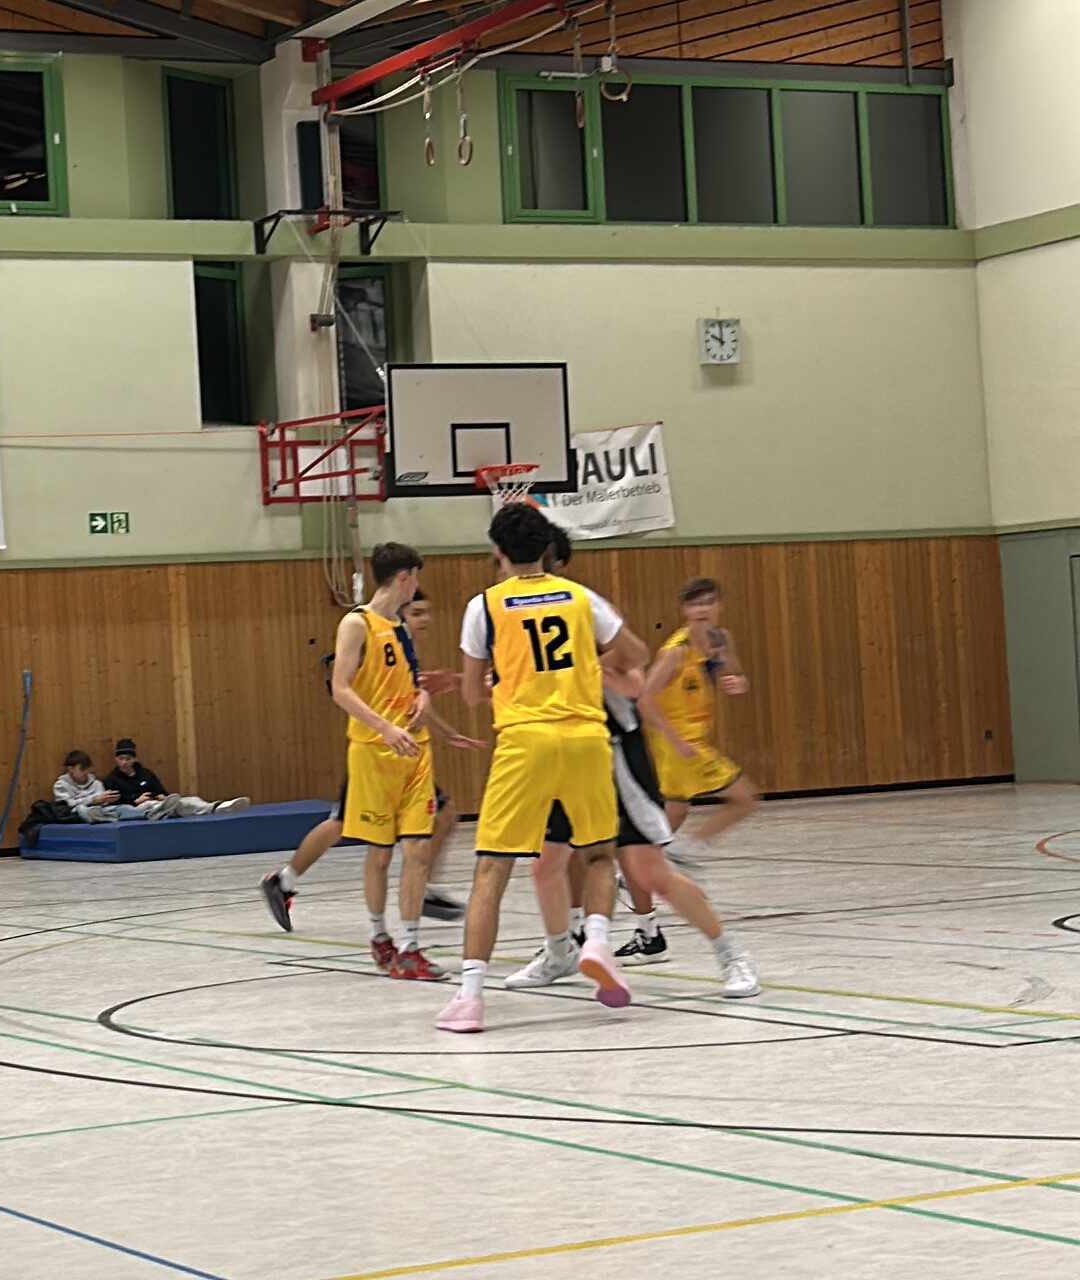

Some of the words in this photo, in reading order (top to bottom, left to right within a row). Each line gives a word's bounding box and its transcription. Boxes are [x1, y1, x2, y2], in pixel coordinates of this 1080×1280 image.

[576, 443, 658, 486] AULI
[561, 495, 583, 507] Der
[383, 642, 396, 666] 8
[522, 616, 574, 672] 12
